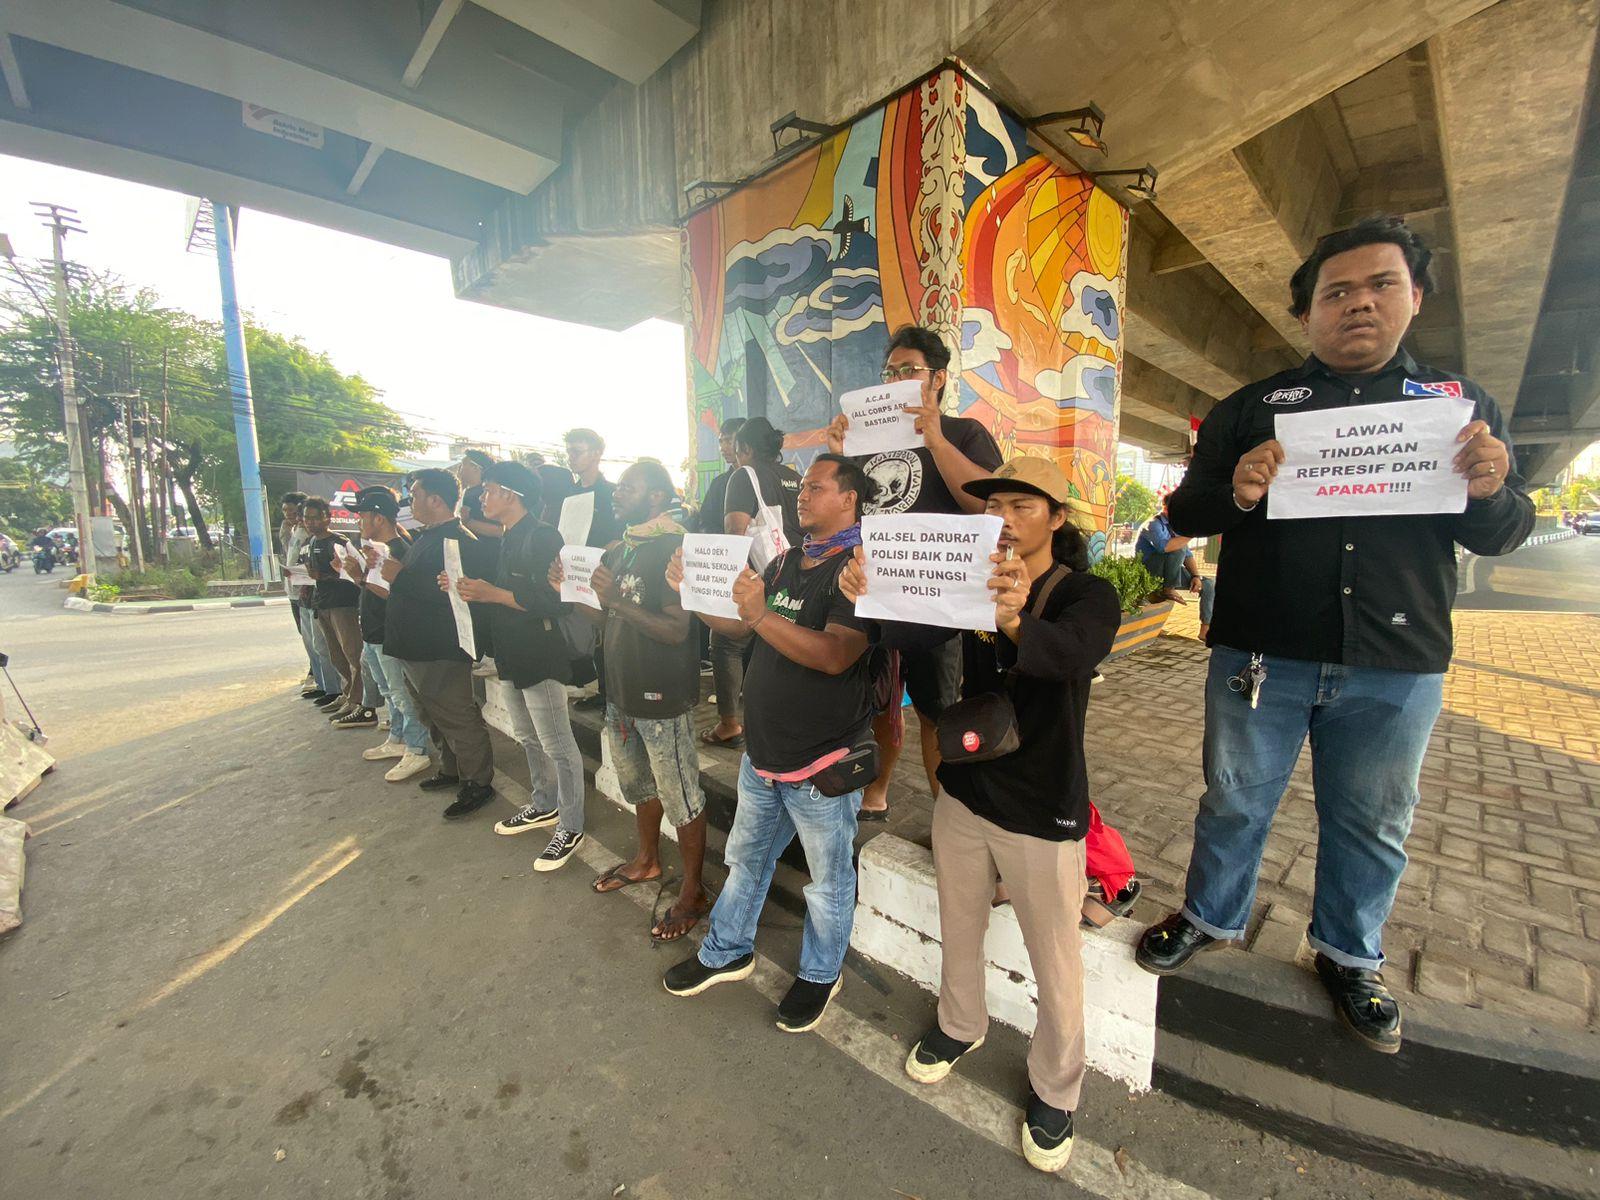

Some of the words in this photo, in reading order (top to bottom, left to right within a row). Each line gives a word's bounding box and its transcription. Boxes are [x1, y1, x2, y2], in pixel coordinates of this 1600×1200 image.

[851, 410, 867, 420] (ALL
[868, 405, 892, 415] CORPS
[893, 402, 908, 411] ARE
[864, 416, 900, 427] BASTARD)
[1335, 422, 1404, 439] LAWAN
[1319, 442, 1418, 459] TINDAKAN
[1296, 463, 1386, 479] REPRESIF
[1391, 460, 1438, 473] DARI
[1316, 481, 1412, 497] APARAT!!!!
[869, 531, 917, 542] KAL-SEL
[920, 532, 980, 544] DARURAT
[694, 547, 711, 556] HALO
[871, 549, 908, 560] POLISI
[912, 551, 942, 562] BAIK
[946, 552, 973, 563] DAN
[711, 562, 738, 572] SEKOLAH
[695, 574, 710, 582] BIAR
[711, 575, 728, 585] TAHU
[877, 567, 916, 579] PAHAM
[919, 570, 967, 582] FUNGSI
[691, 586, 712, 596] FUNGSI
[712, 589, 732, 599] POLISI
[902, 585, 941, 597] POLISI
